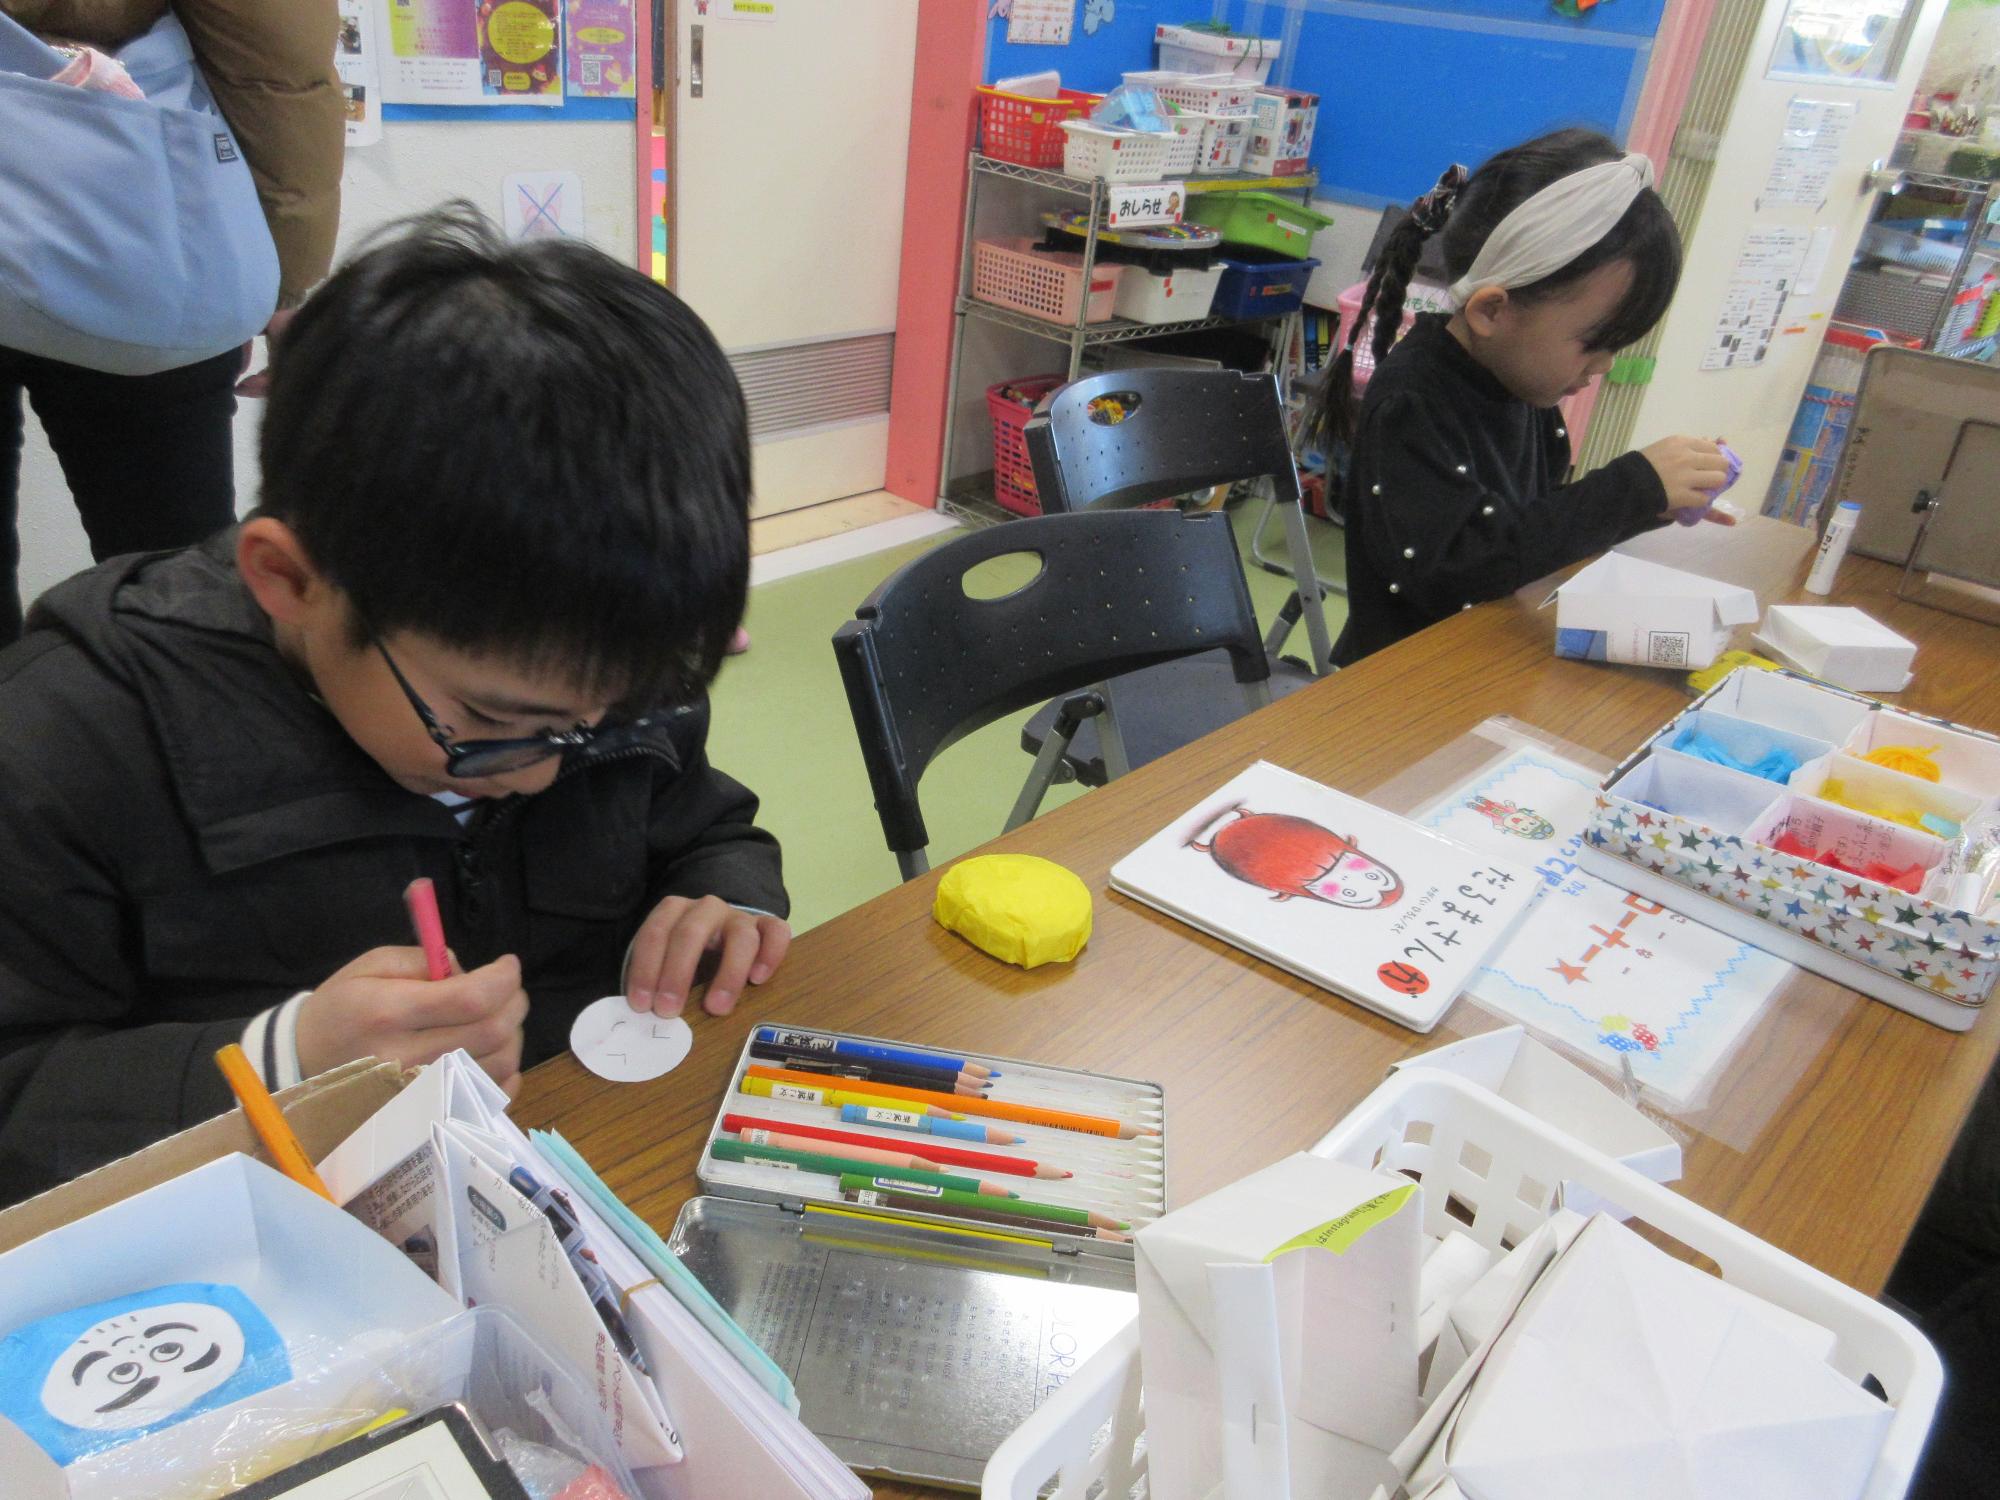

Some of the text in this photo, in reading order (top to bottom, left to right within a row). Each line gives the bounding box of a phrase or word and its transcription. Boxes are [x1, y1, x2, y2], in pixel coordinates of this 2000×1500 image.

[1119, 197, 1162, 217] おしらせ
[1379, 866, 1516, 999] だるまさんが
